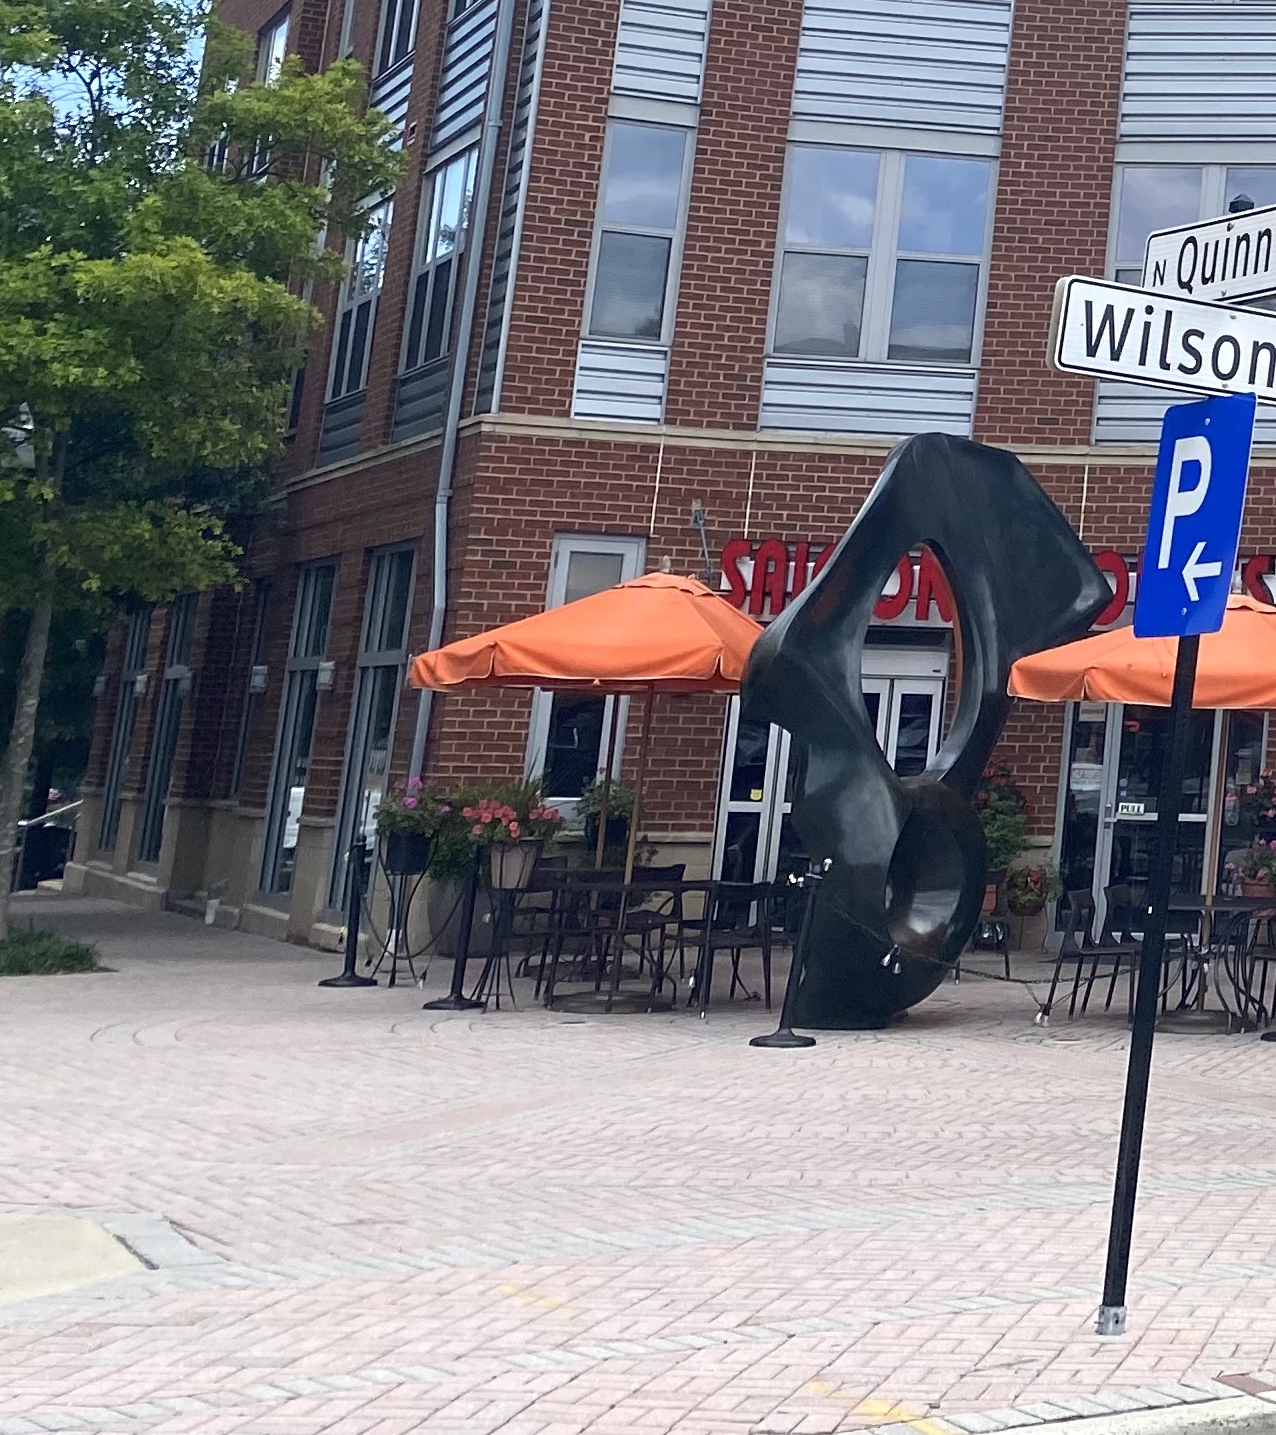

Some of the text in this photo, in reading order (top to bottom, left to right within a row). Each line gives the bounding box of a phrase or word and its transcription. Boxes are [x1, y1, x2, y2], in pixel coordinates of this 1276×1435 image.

[1152, 259, 1167, 288] N
[1176, 225, 1273, 295] Quinn
[1157, 435, 1212, 569] P
